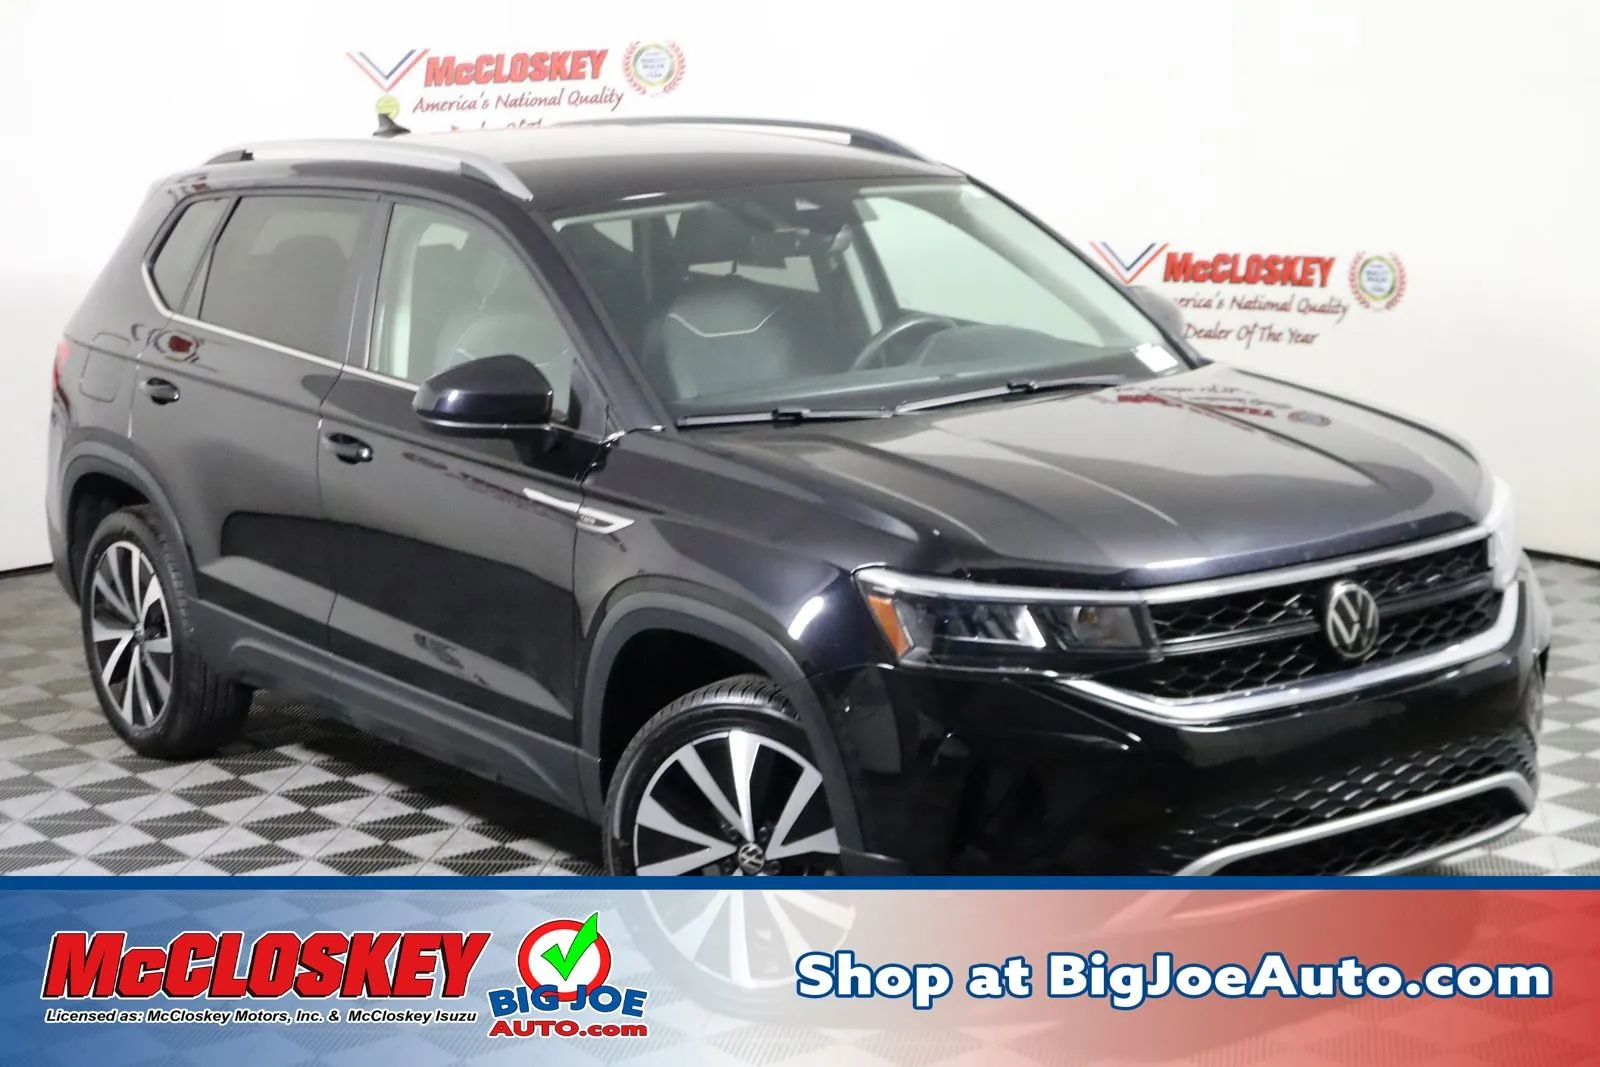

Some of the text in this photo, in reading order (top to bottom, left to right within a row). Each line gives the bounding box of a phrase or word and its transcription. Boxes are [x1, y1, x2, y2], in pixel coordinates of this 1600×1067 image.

[423, 48, 609, 88] McCLOSKEY
[412, 91, 489, 113] America's
[495, 88, 565, 110] National
[567, 85, 624, 112] Quality
[1163, 251, 1336, 287] McCLOSKEY
[1175, 291, 1349, 324] erica's National Quality
[1184, 320, 1320, 349] Dealer Of The Year
